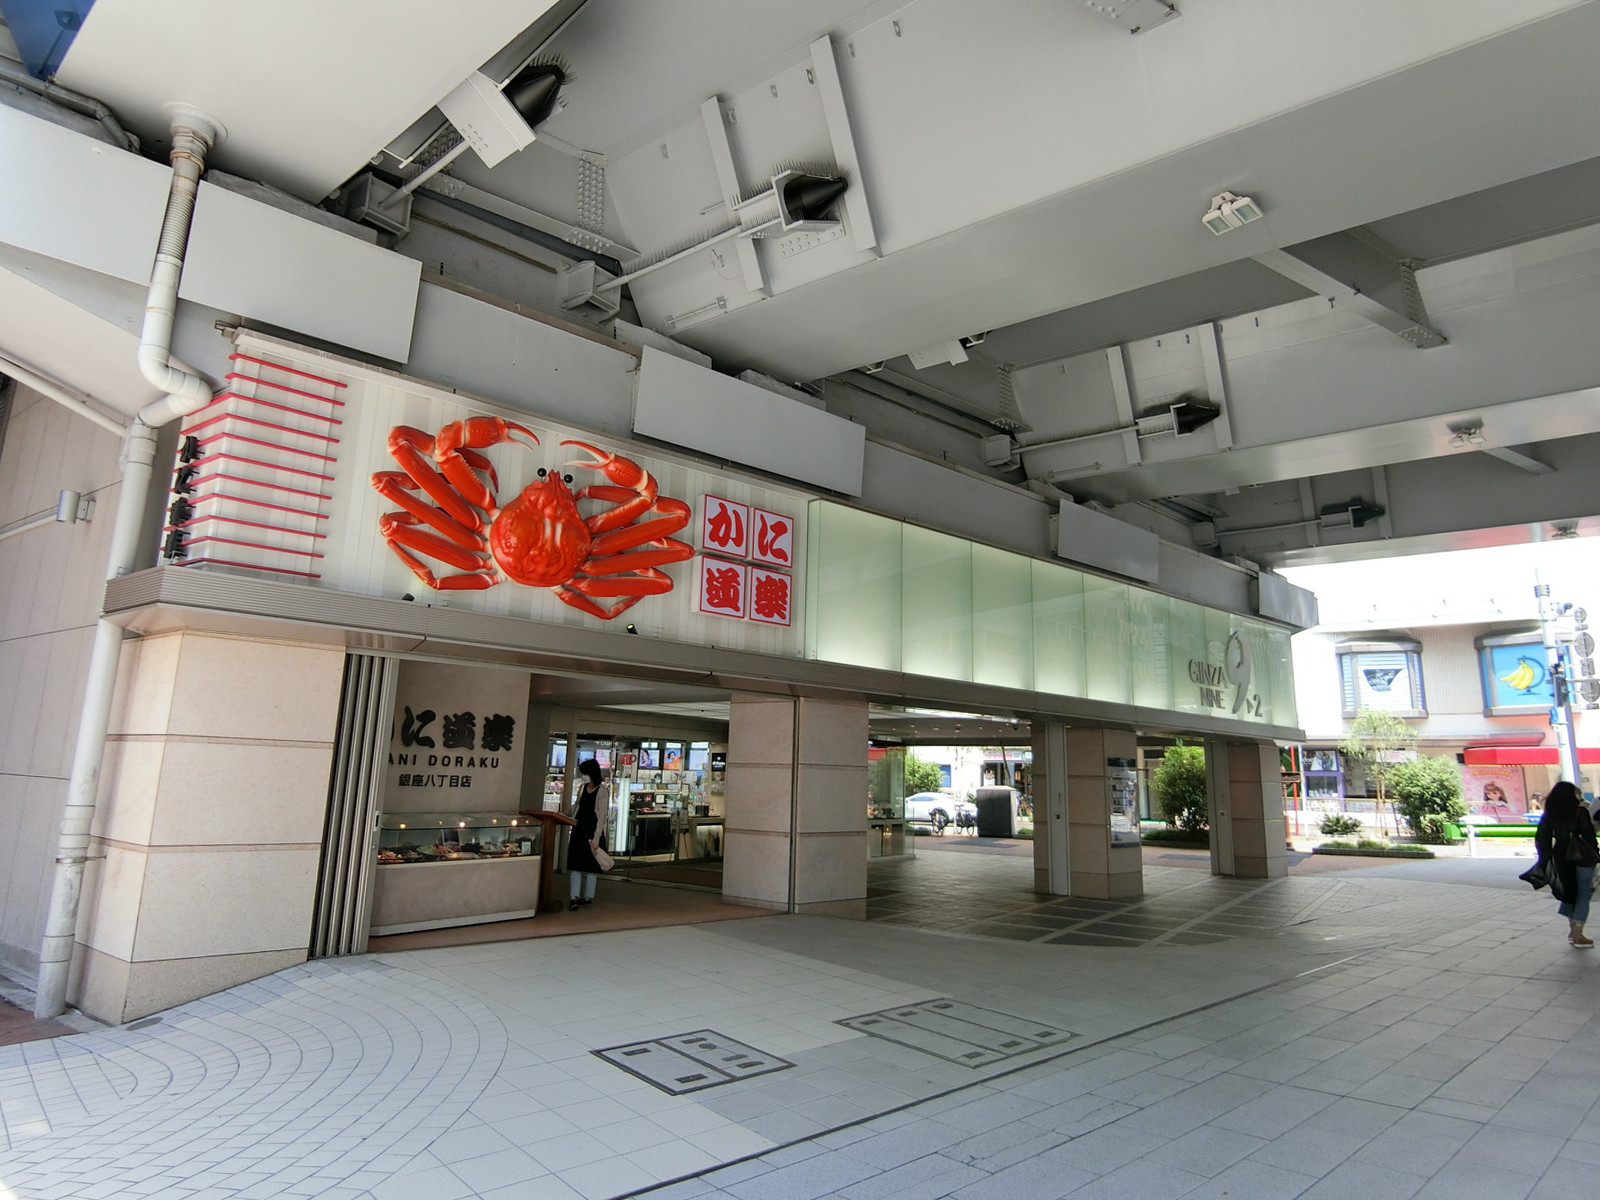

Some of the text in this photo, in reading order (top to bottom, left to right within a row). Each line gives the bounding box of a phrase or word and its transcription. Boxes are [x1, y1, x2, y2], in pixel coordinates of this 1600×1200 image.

[707, 502, 788, 562] かに
[1188, 659, 1228, 689] GINZA
[1200, 687, 1226, 709] NINE
[428, 755, 500, 768] DORAKU
[398, 773, 472, 788] 銀座八丁目店
